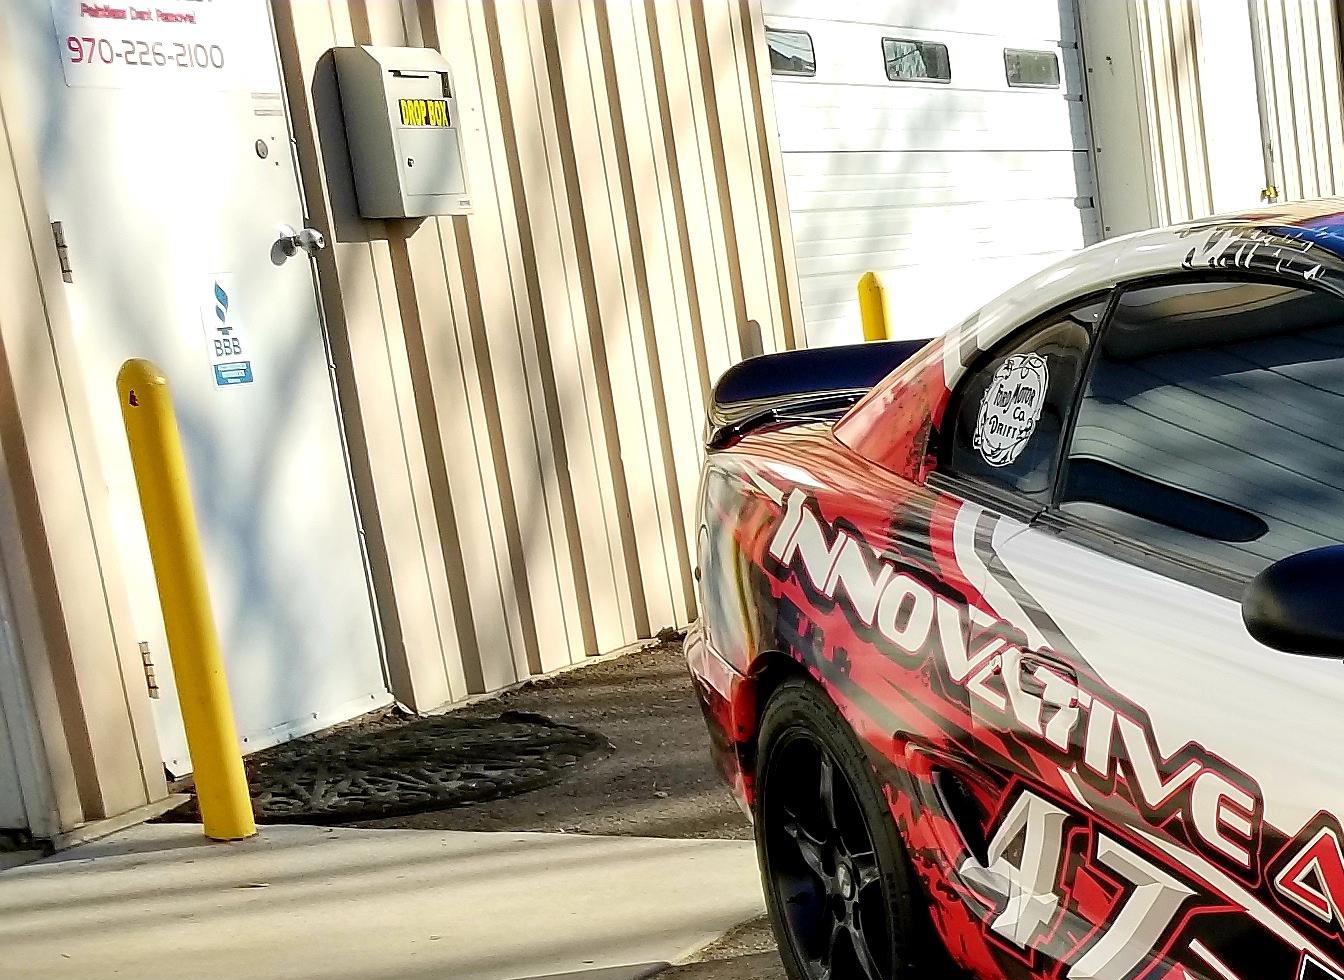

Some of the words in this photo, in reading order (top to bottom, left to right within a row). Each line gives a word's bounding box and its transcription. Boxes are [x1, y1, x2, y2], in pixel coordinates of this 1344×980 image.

[67, 37, 224, 69] 970-226-2100
[400, 100, 427, 126] DROP
[427, 100, 449, 127] BOX
[213, 338, 242, 357] BBB
[989, 415, 1018, 439] DRIFT
[768, 488, 1257, 867] INNOVATIVE
